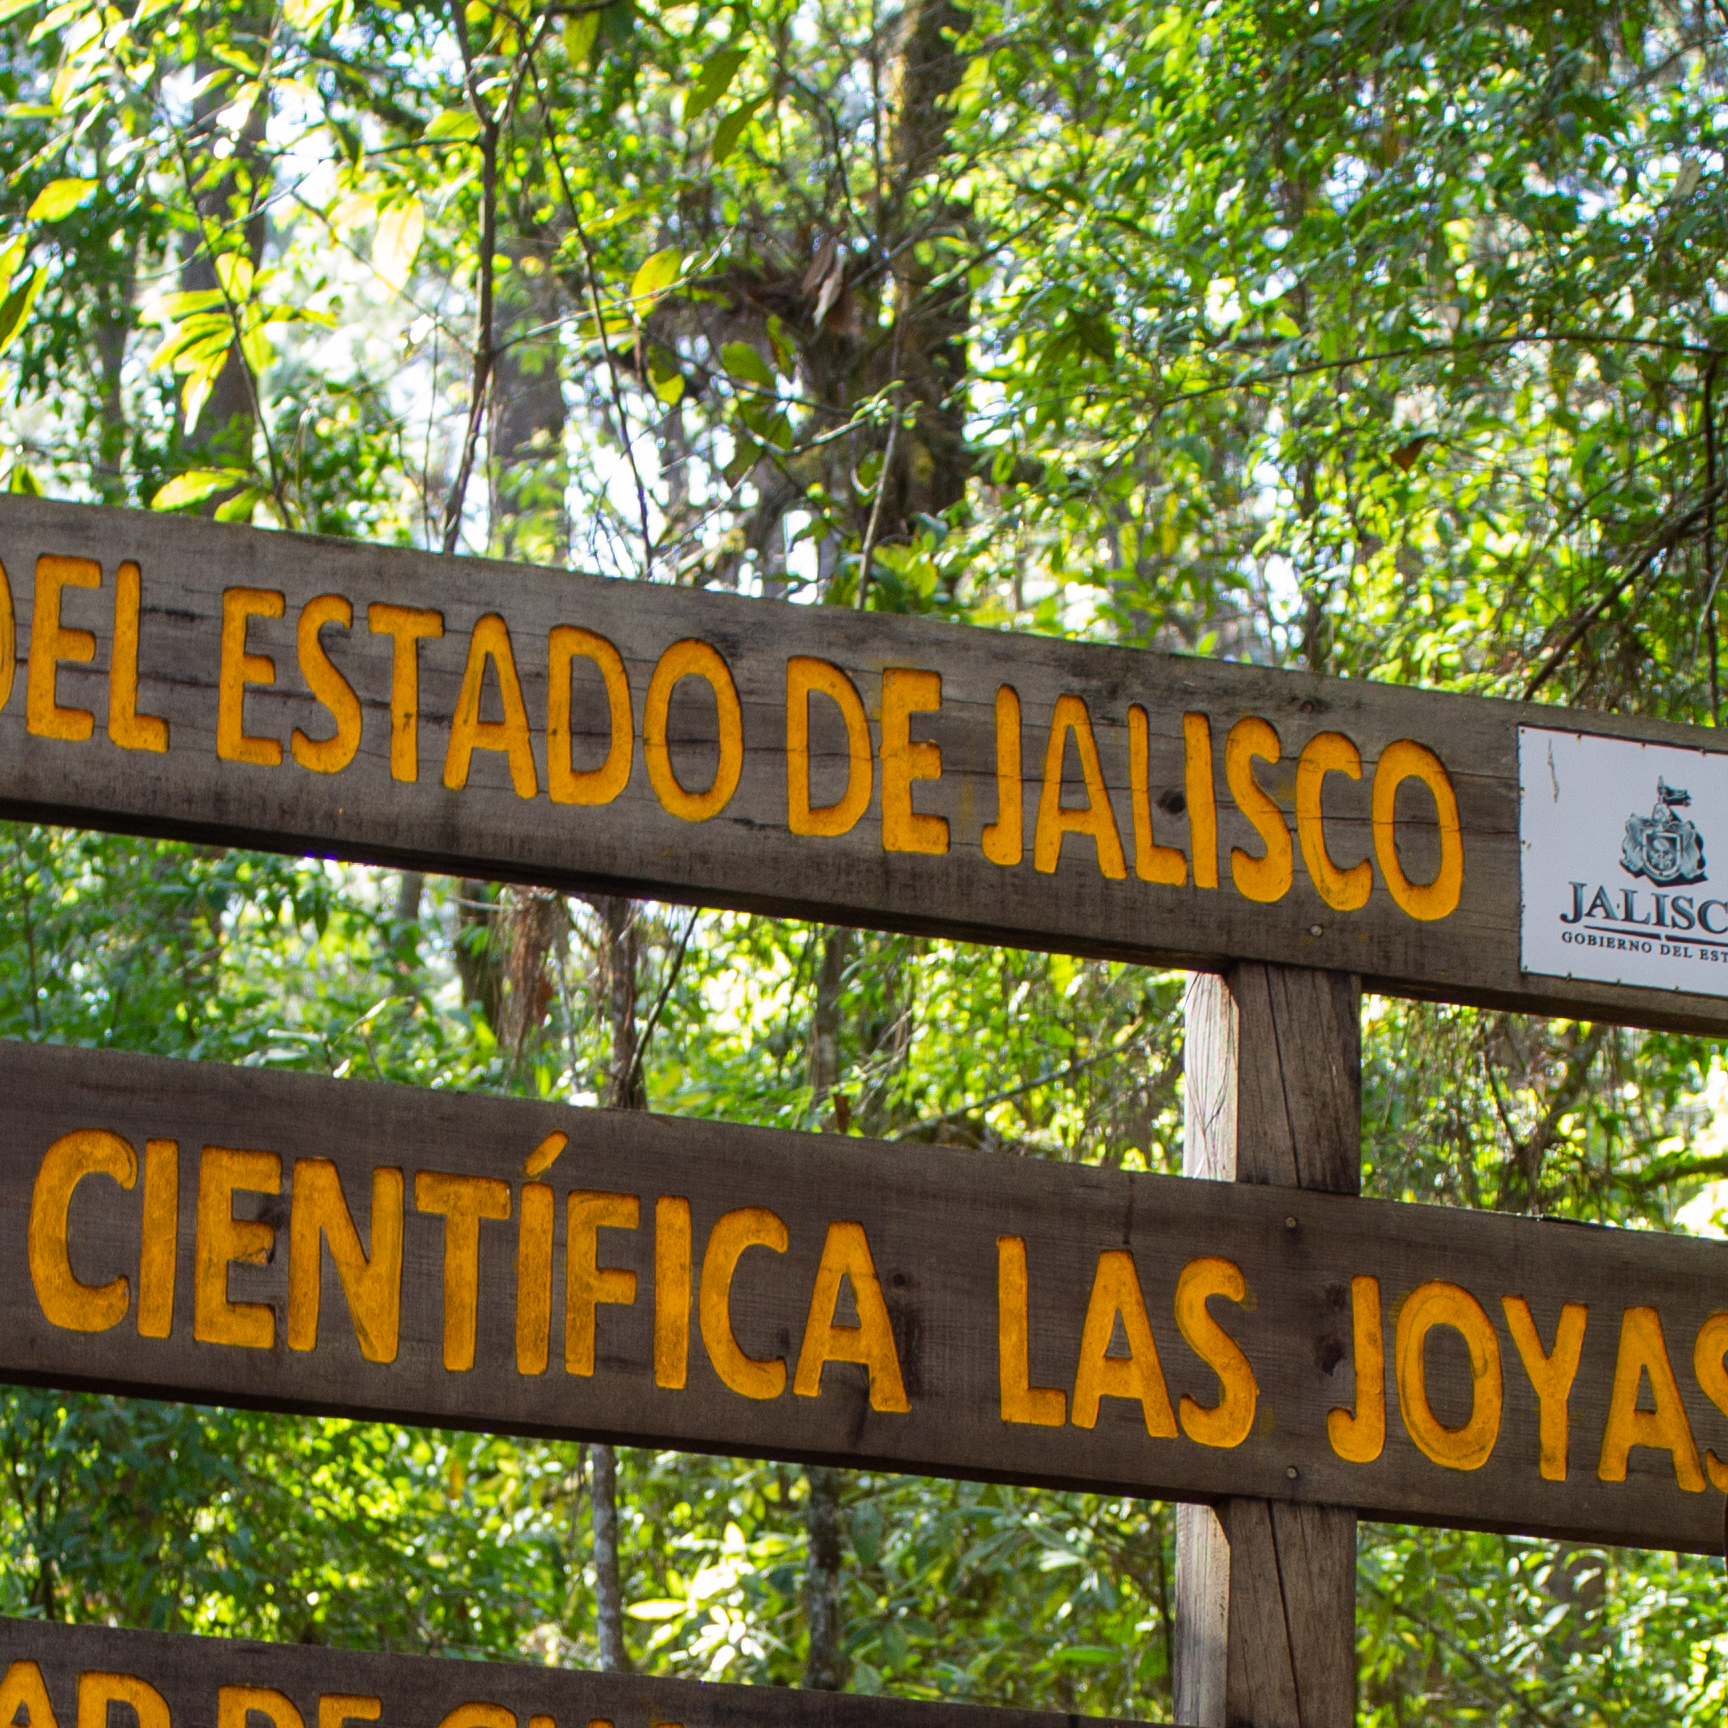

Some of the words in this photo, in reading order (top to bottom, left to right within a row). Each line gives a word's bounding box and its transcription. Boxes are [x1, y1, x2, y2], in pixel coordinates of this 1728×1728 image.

[216, 588, 744, 823] ESTADO
[785, 657, 949, 856] DE
[980, 686, 1465, 922] JALISCO
[1561, 931, 1652, 953] GOBIERNO
[1659, 943, 1693, 959] DEL
[27, 1130, 912, 1414] CIENTÍFICA
[995, 1235, 1261, 1449] LAS
